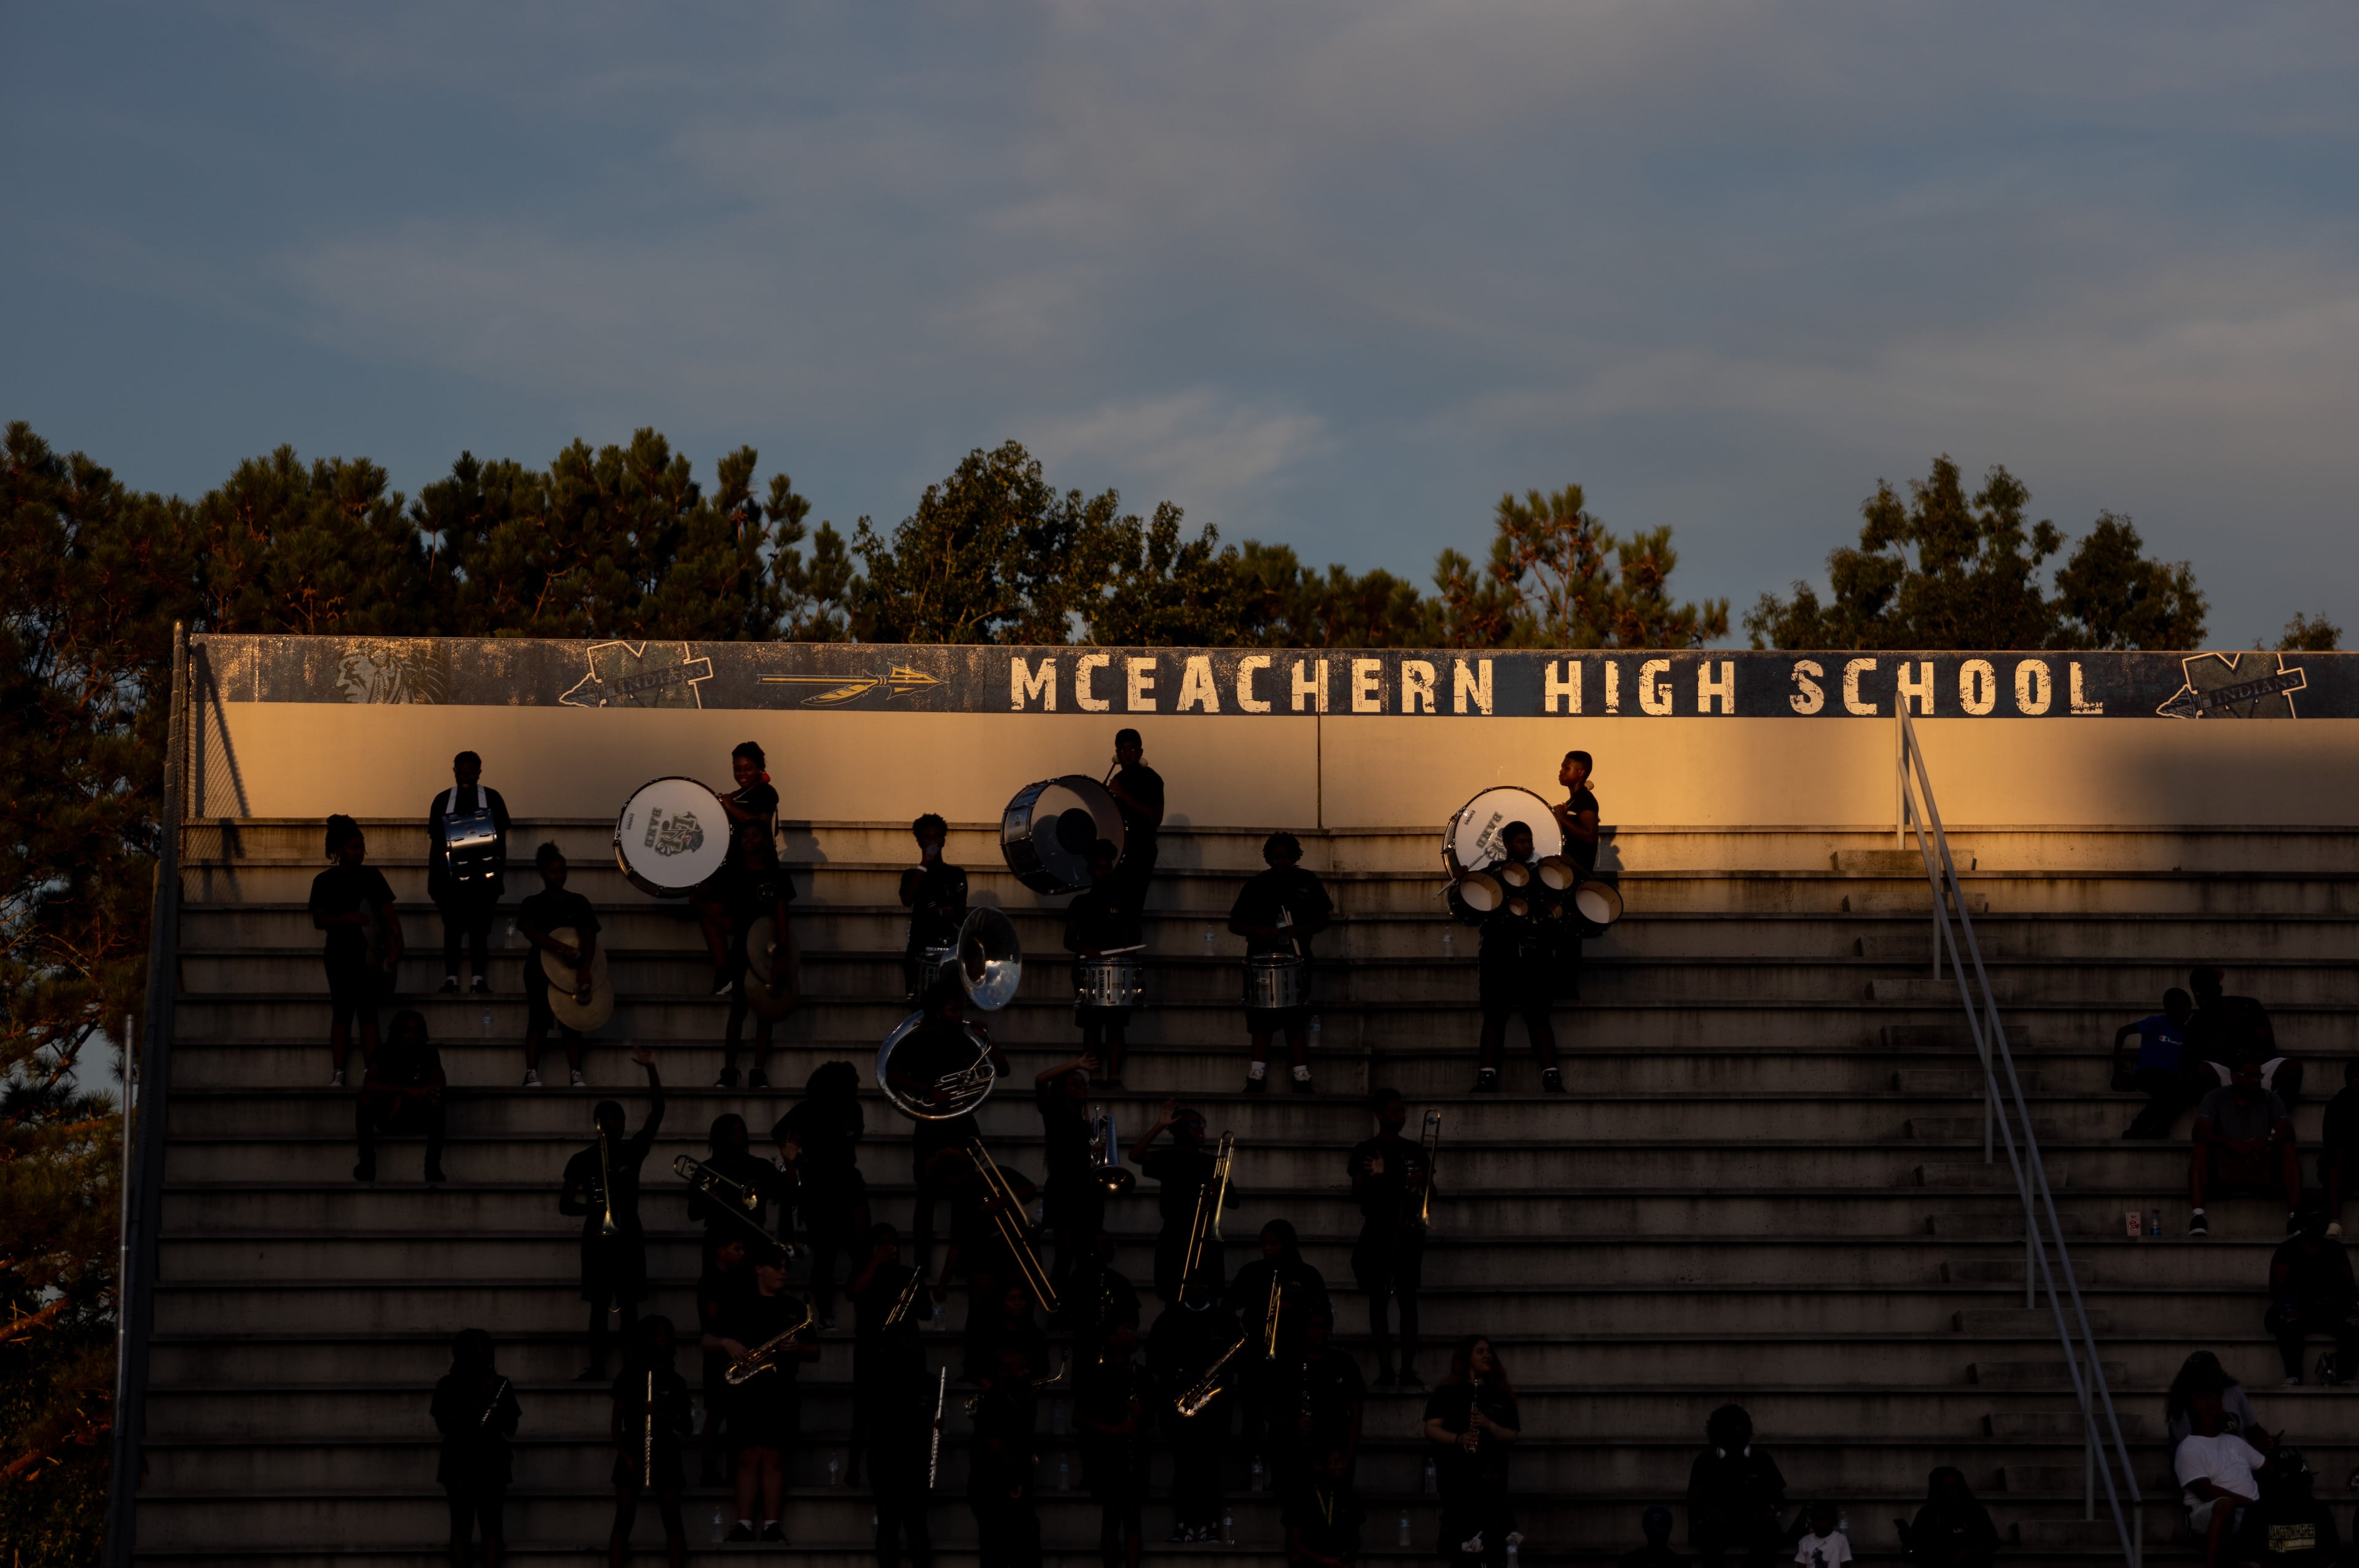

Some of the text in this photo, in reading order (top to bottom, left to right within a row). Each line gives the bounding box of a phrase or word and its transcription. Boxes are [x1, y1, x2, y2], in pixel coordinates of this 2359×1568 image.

[625, 665, 706, 692] INDIANS
[1011, 653, 2105, 716] MCEACHERN HIGH SCHOOL
[2215, 675, 2299, 704] INDIANS
[644, 806, 663, 848] BAND
[1464, 809, 1476, 826] EVANS
[1476, 811, 1504, 849] BAND
